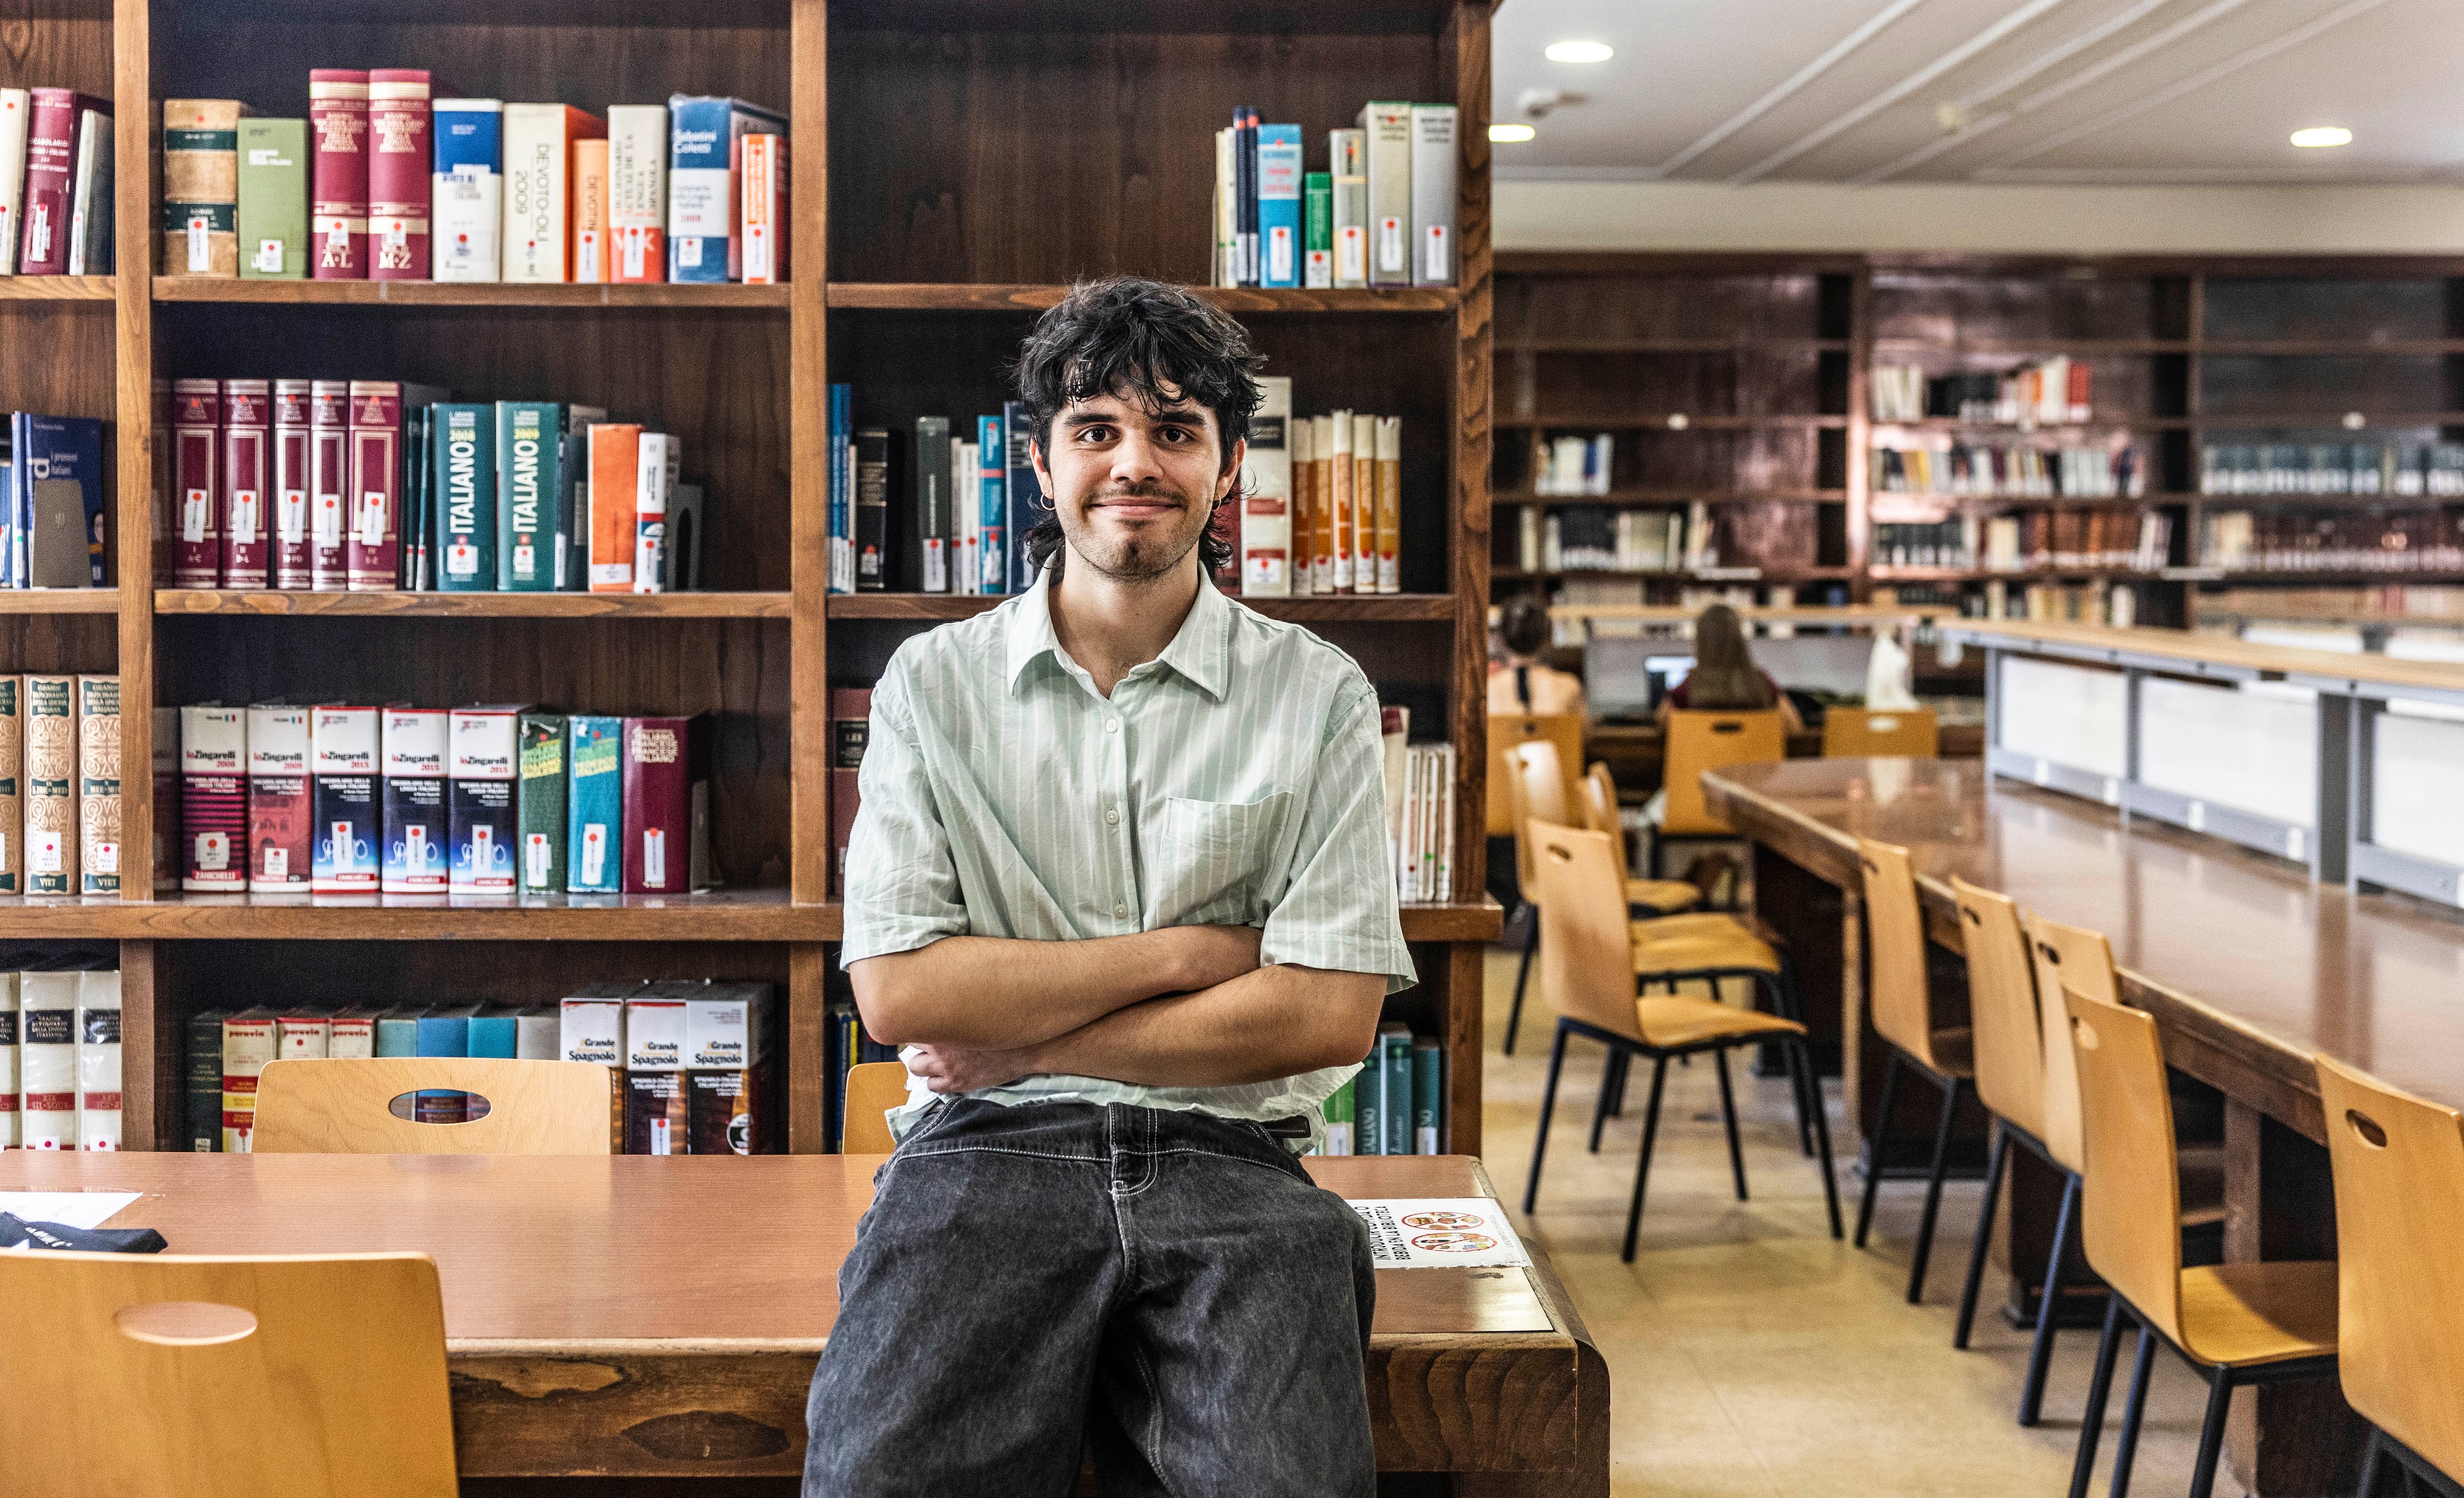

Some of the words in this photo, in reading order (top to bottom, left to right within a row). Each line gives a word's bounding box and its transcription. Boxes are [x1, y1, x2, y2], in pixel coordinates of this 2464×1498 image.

[514, 169, 529, 215] 2009
[536, 143, 550, 242] DEVOTO-OLI
[613, 231, 656, 251] VX
[450, 441, 475, 534] ITALIANO
[513, 440, 539, 533] ITALIANO
[569, 1050, 615, 1062] Spagnolo
[632, 1054, 678, 1065] Spagnolo
[695, 1053, 742, 1065] Spagnolo
[1375, 1206, 1398, 1230] BIBLIOTECA
[1391, 1243, 1411, 1260] BEBIDA
